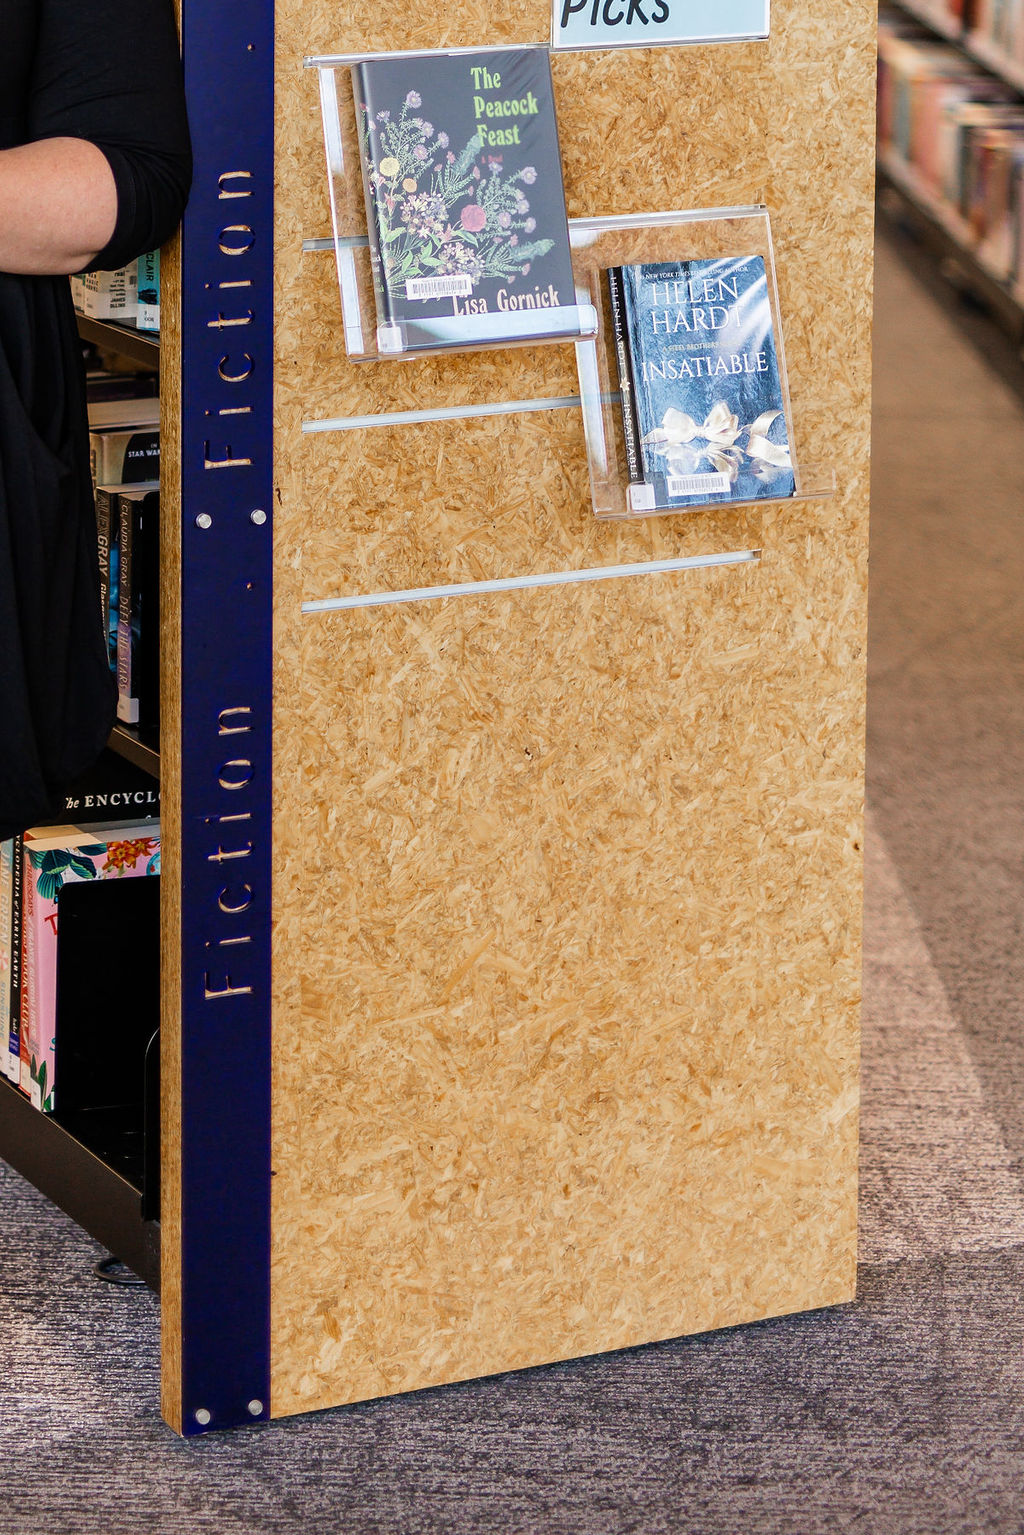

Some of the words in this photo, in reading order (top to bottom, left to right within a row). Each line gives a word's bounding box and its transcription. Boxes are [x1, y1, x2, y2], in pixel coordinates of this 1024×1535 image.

[470, 66, 501, 90] The
[473, 91, 539, 119] Peacock
[476, 124, 521, 147] Feast
[452, 294, 488, 316] Lisa
[496, 284, 560, 313] Gornick
[651, 276, 739, 305] HELEN
[204, 170, 256, 470] Fiction
[650, 305, 744, 335] HARDT
[610, 276, 621, 318] HELEN
[616, 322, 626, 365] HARDT
[623, 403, 638, 479] INSATIABLE
[641, 351, 769, 382] INSATIABLE
[128, 450, 145, 458] STAR
[146, 448, 160, 457] WAR
[120, 503, 129, 552] CLAUDIA
[97, 534, 108, 576] GRAY
[84, 791, 160, 807] ENCYCL
[204, 707, 256, 1000] Fiction
[0, 851, 10, 889] JANE
